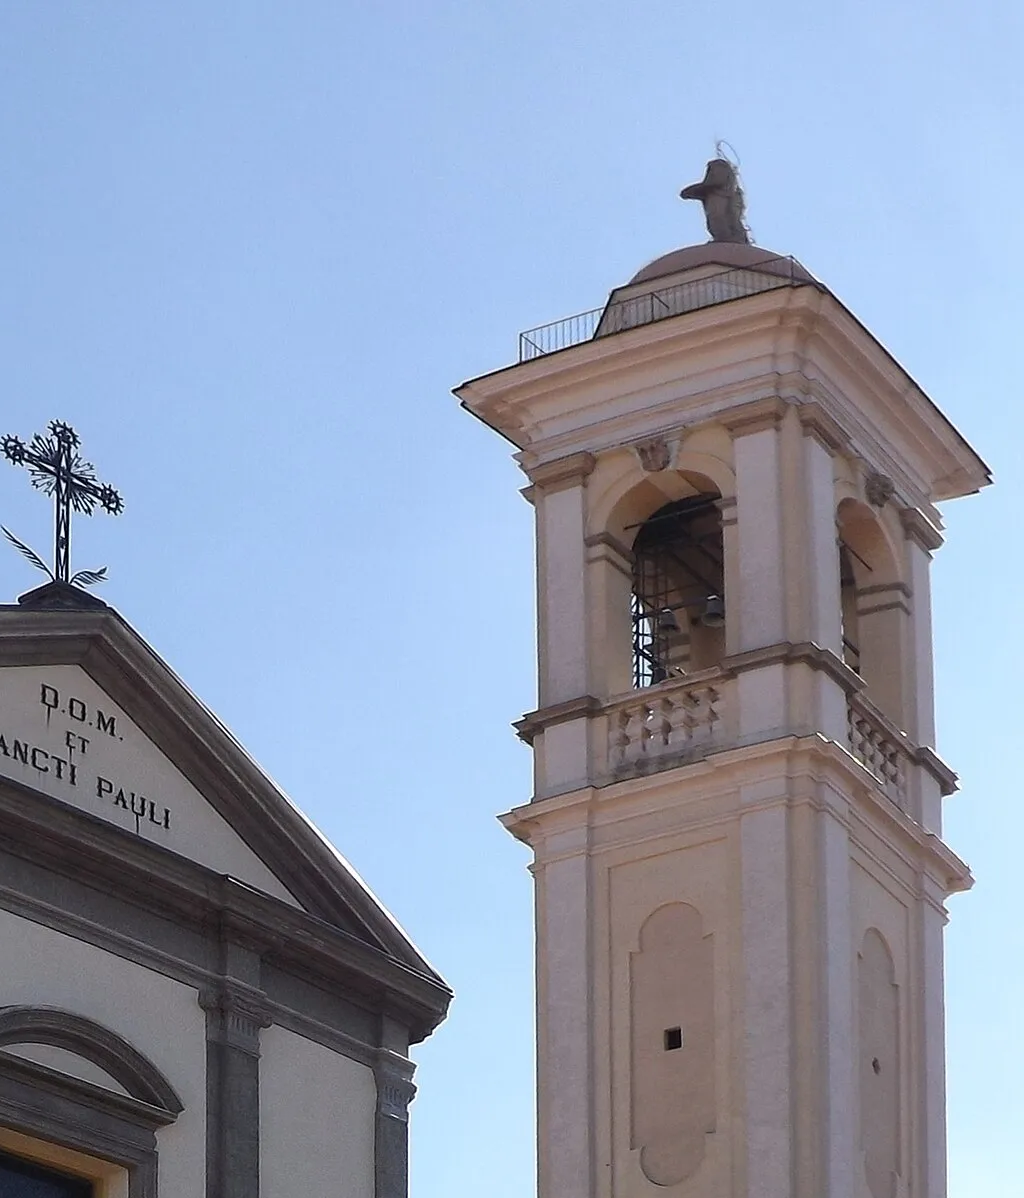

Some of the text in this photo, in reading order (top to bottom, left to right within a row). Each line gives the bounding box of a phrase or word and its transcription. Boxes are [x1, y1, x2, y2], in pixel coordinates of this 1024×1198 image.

[40, 683, 124, 741] D.O.M.
[65, 731, 90, 754] ET
[96, 776, 171, 830] PAULI
